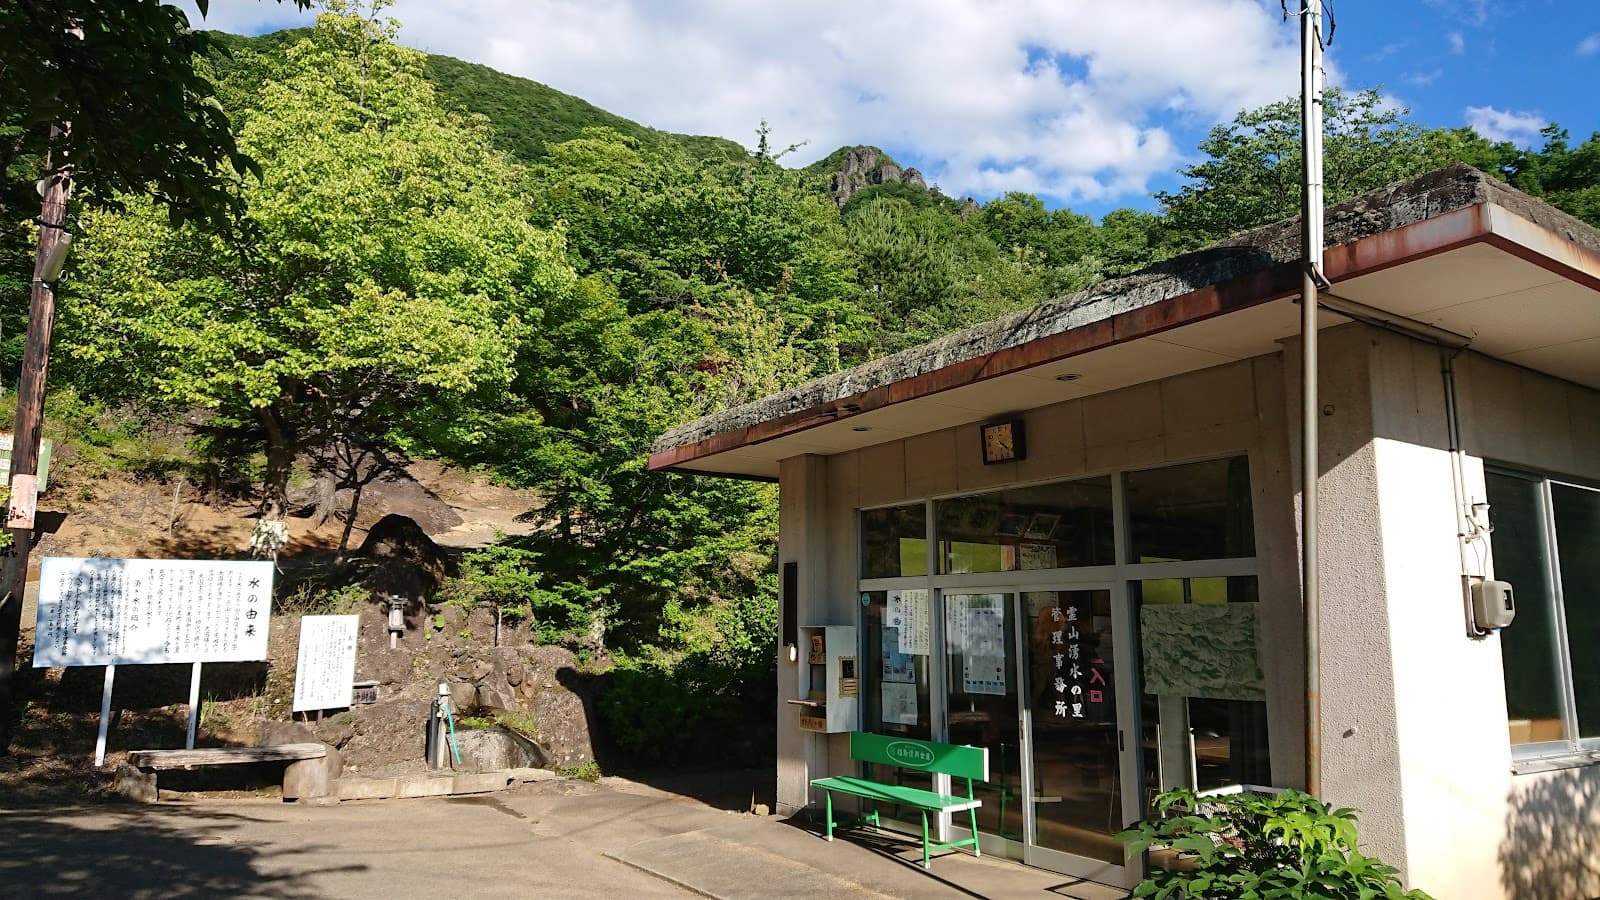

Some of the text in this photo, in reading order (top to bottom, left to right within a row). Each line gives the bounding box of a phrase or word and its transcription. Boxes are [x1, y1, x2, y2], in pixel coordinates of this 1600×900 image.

[245, 577, 261, 638] 水の由来
[1051, 607, 1068, 718] 管理事務所
[1066, 606, 1084, 718] 霊山湧水の里
